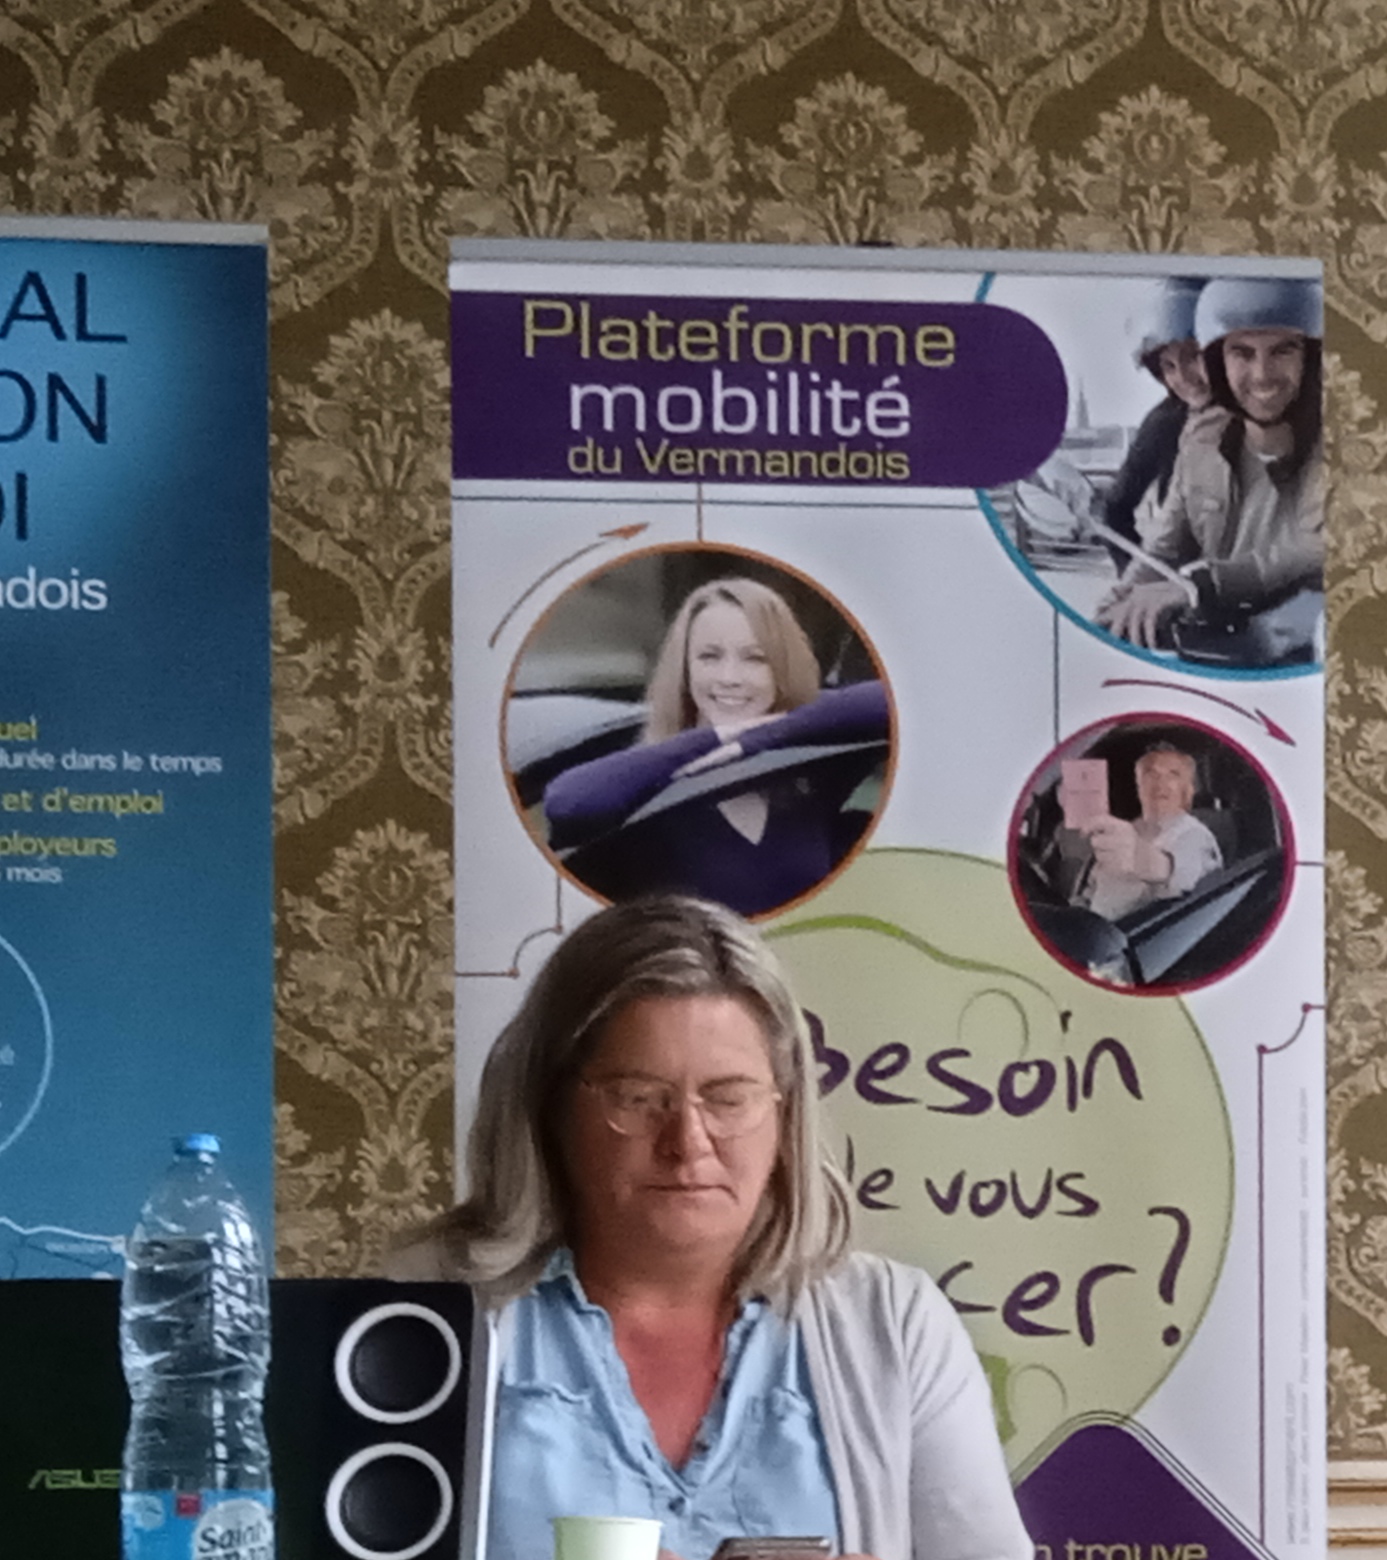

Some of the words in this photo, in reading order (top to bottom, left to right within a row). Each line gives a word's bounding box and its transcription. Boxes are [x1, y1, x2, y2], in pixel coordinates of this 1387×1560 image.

[522, 299, 957, 368] Plateforme
[569, 370, 911, 439] mobilité
[567, 438, 622, 476] du
[636, 440, 911, 481] Vermandois
[61, 748, 118, 771] dans
[122, 750, 144, 772] le
[150, 753, 223, 776] temps
[2, 790, 34, 812] et
[42, 787, 164, 819] d'emploi
[6, 866, 64, 884] mois
[924, 1167, 1101, 1219] vous
